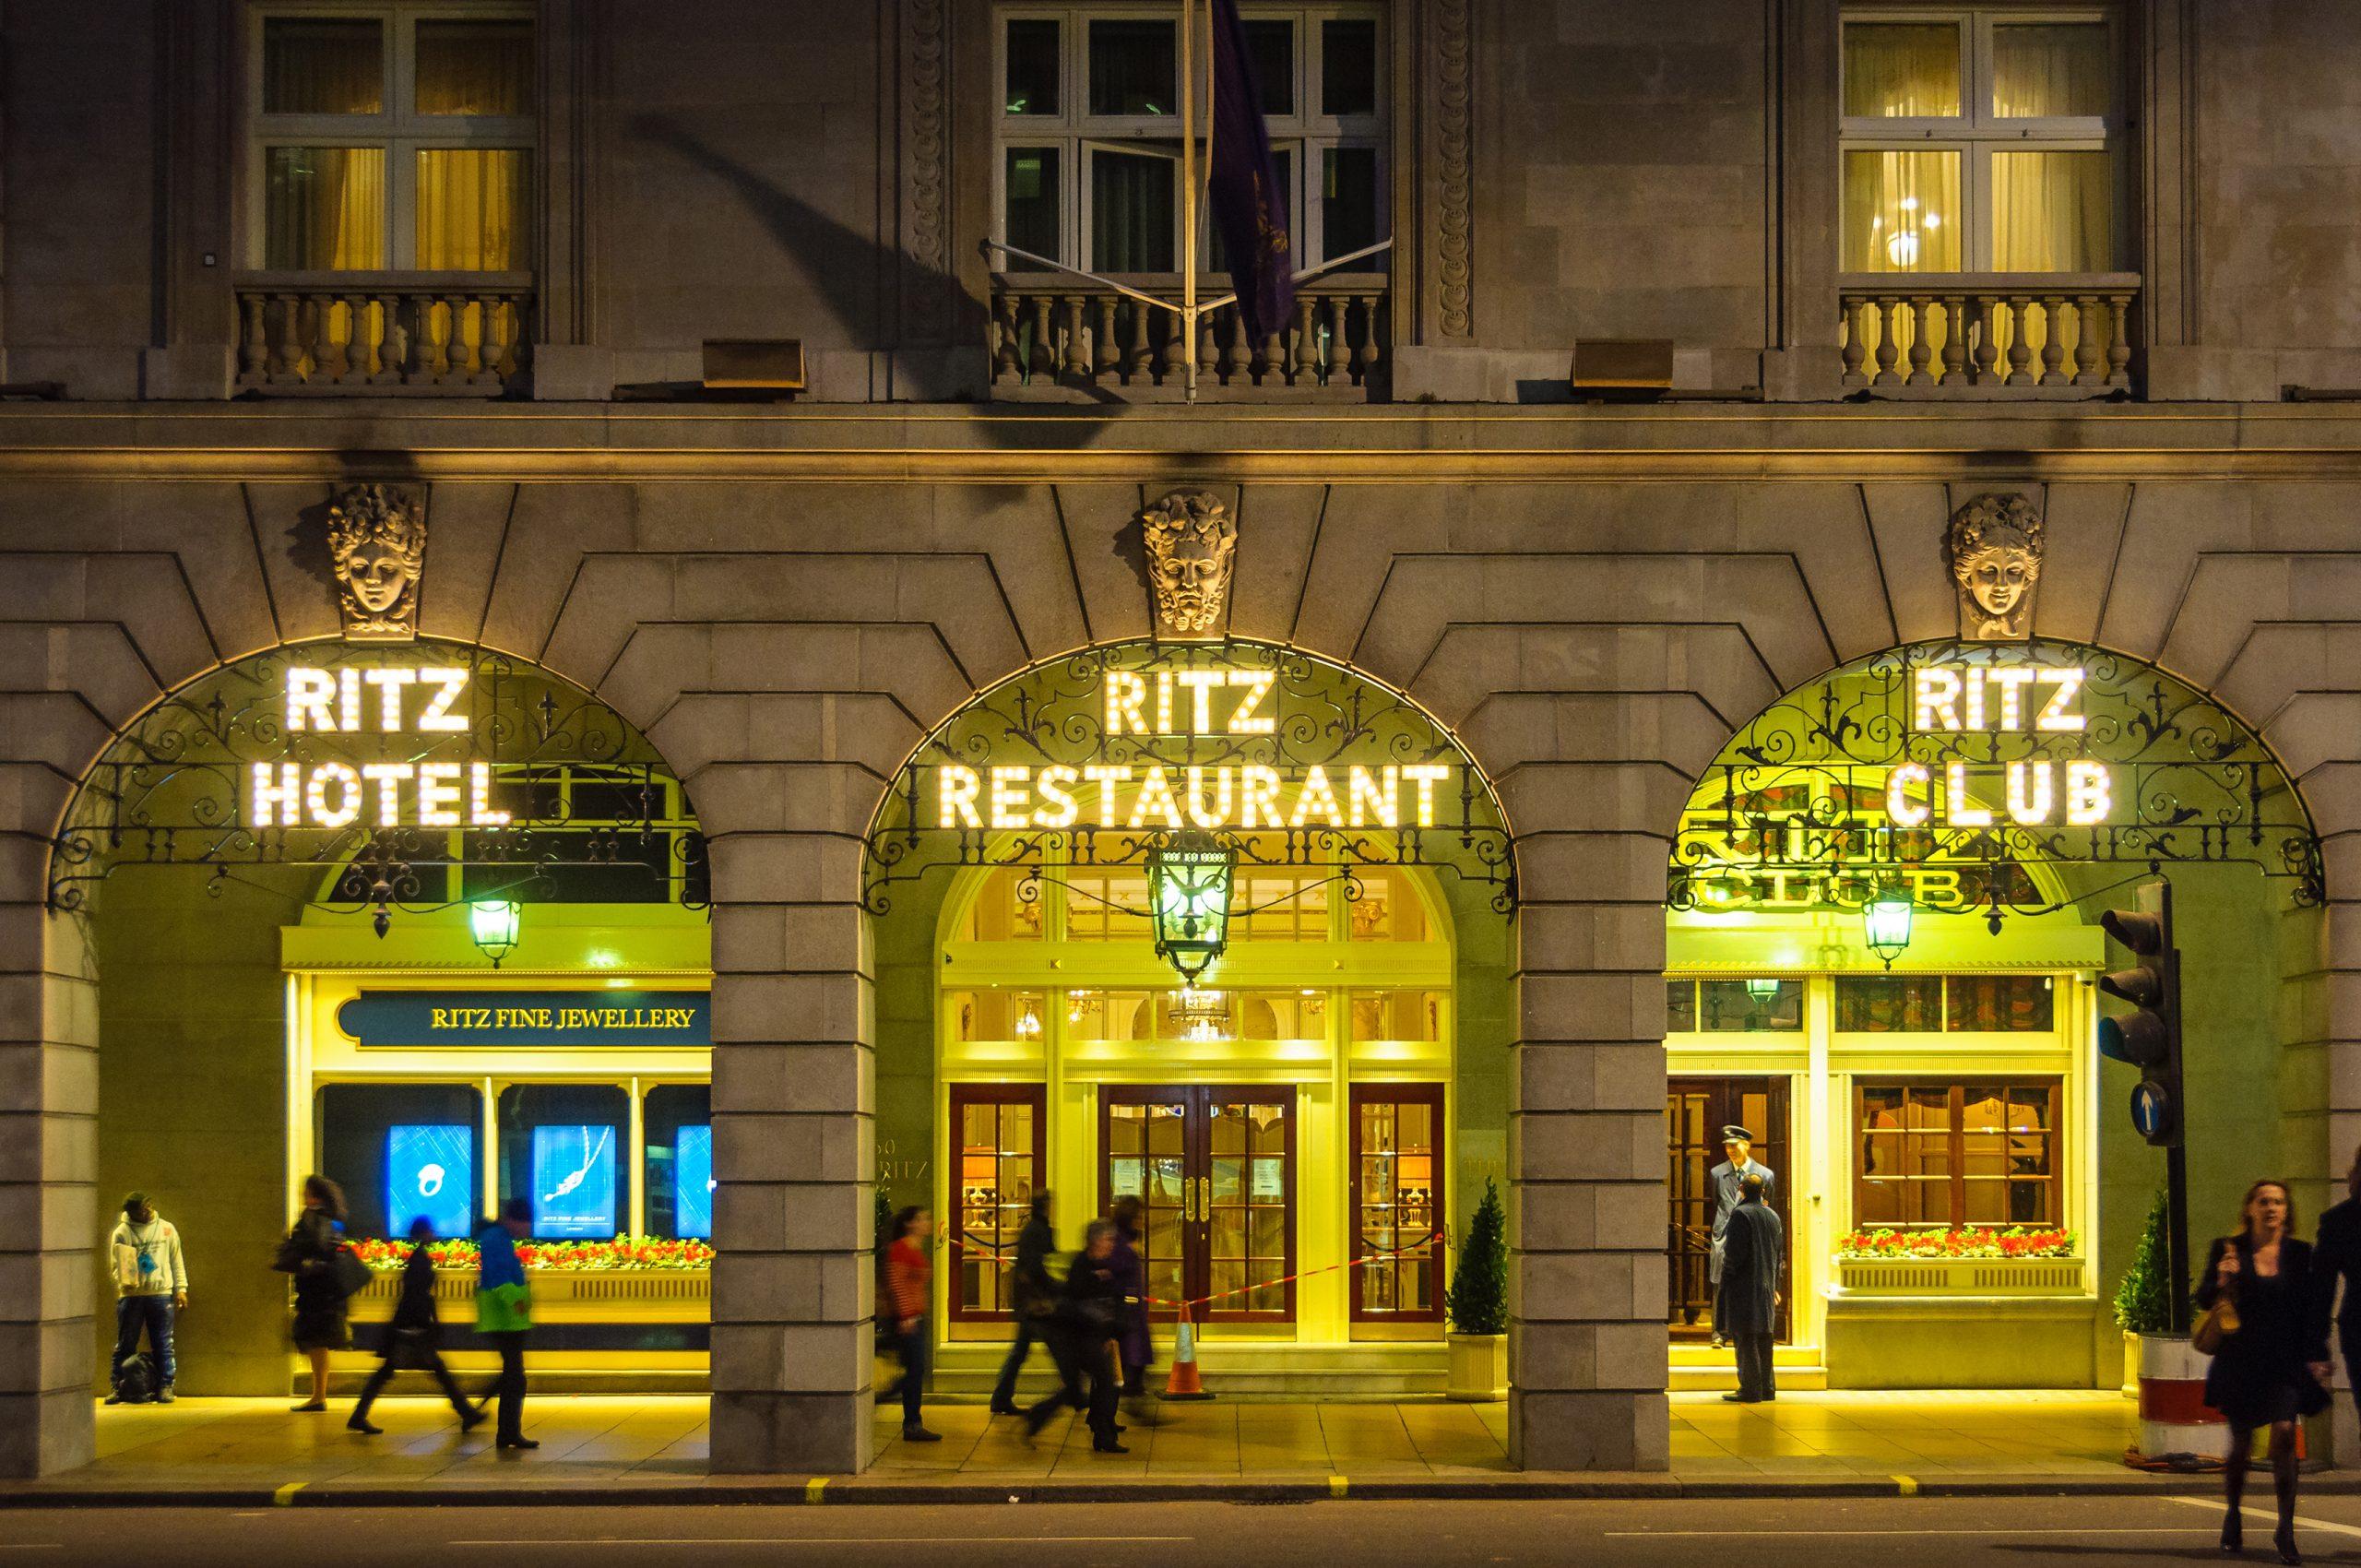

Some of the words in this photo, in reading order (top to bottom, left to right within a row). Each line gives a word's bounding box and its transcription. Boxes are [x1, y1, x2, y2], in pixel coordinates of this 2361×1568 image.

[285, 667, 469, 732] RITZ
[1105, 670, 1276, 735] RITZ
[1914, 667, 2086, 732] RITZ
[253, 762, 511, 828] HOTEL
[938, 765, 1450, 829] RESTAURANT
[1886, 760, 2112, 827] CLUB
[1694, 865, 1964, 908] CLUB
[431, 1008, 492, 1028] RITZ
[495, 1008, 553, 1028] FINE
[555, 1008, 696, 1029] JEWELLERY
